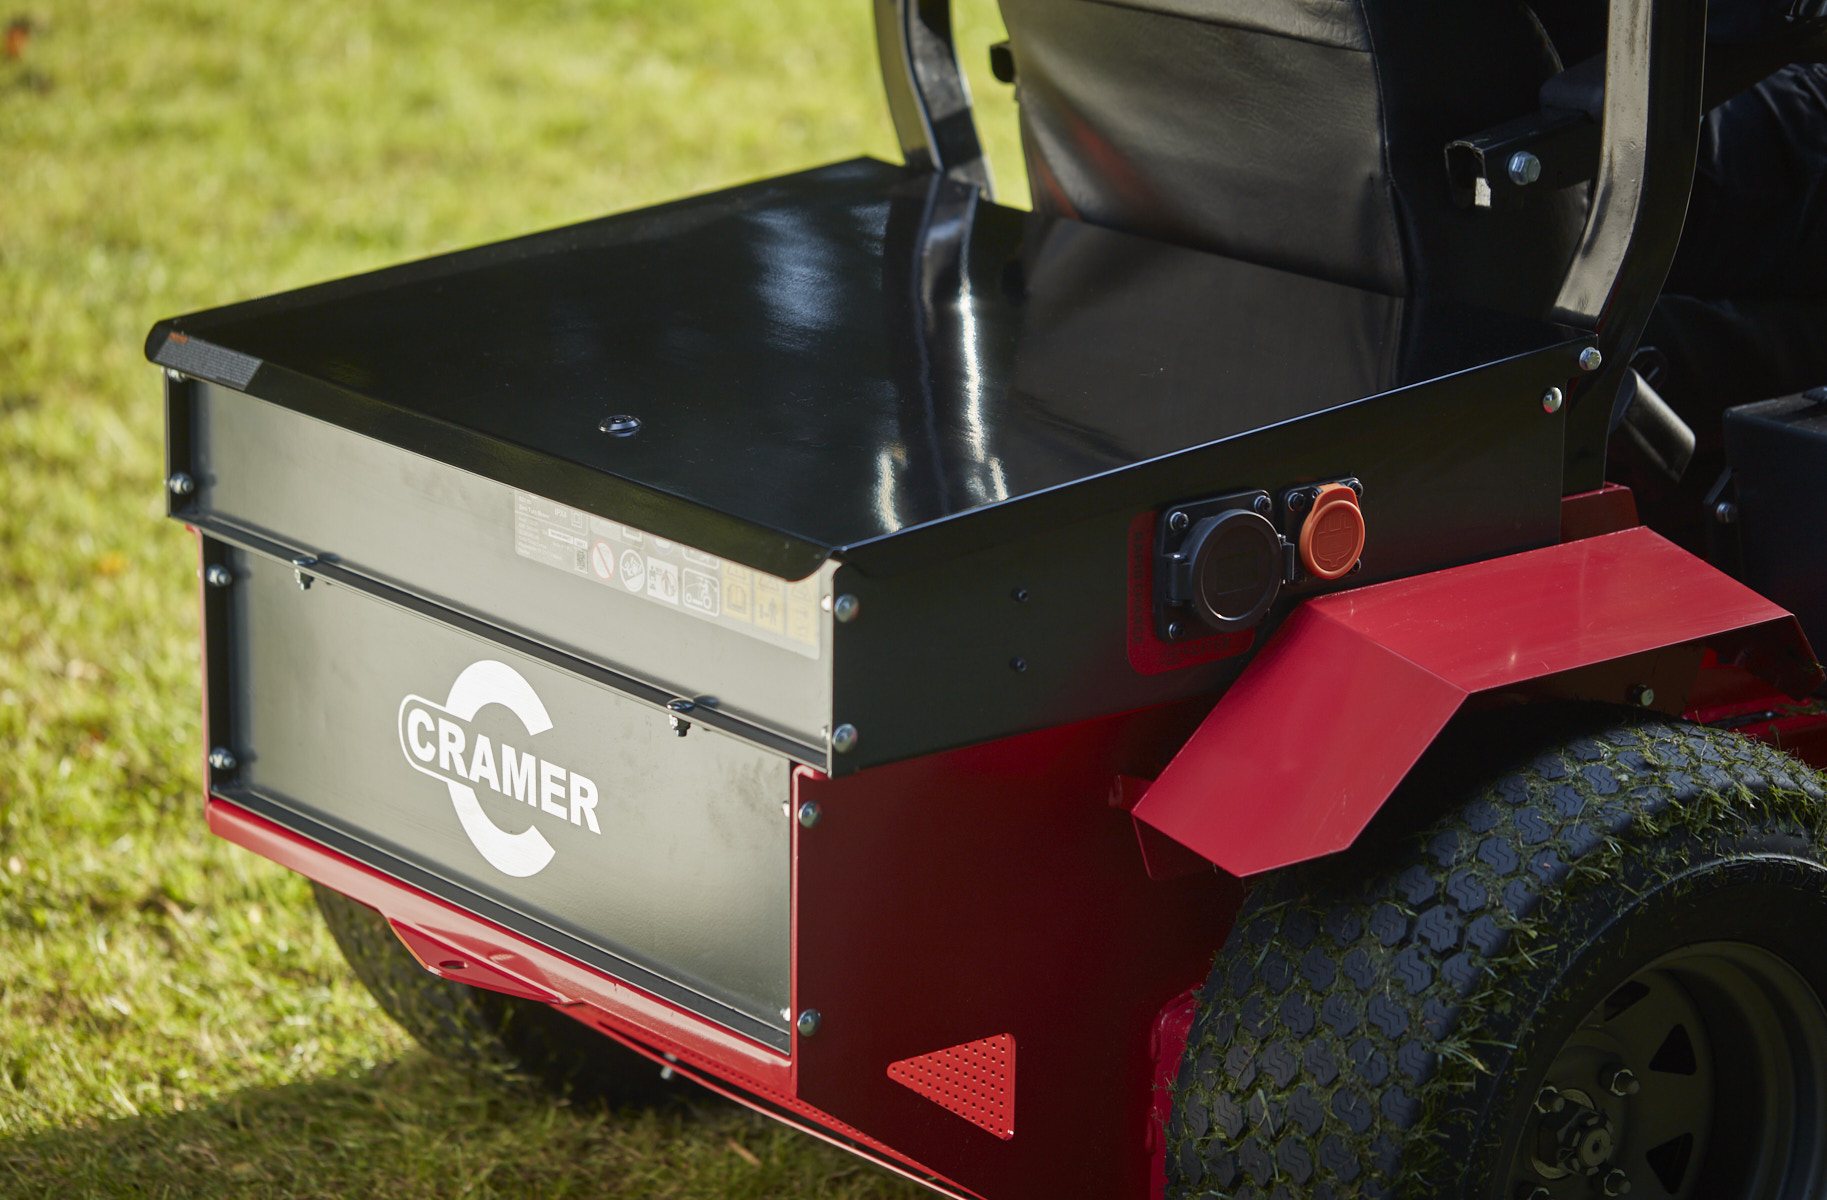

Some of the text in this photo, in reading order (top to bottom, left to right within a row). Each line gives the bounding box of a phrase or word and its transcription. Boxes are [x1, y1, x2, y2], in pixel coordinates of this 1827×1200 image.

[1132, 531, 1144, 646] RAPID CHARGE
[1183, 636, 1230, 659] FASTER
[407, 708, 602, 835] CRAMER
